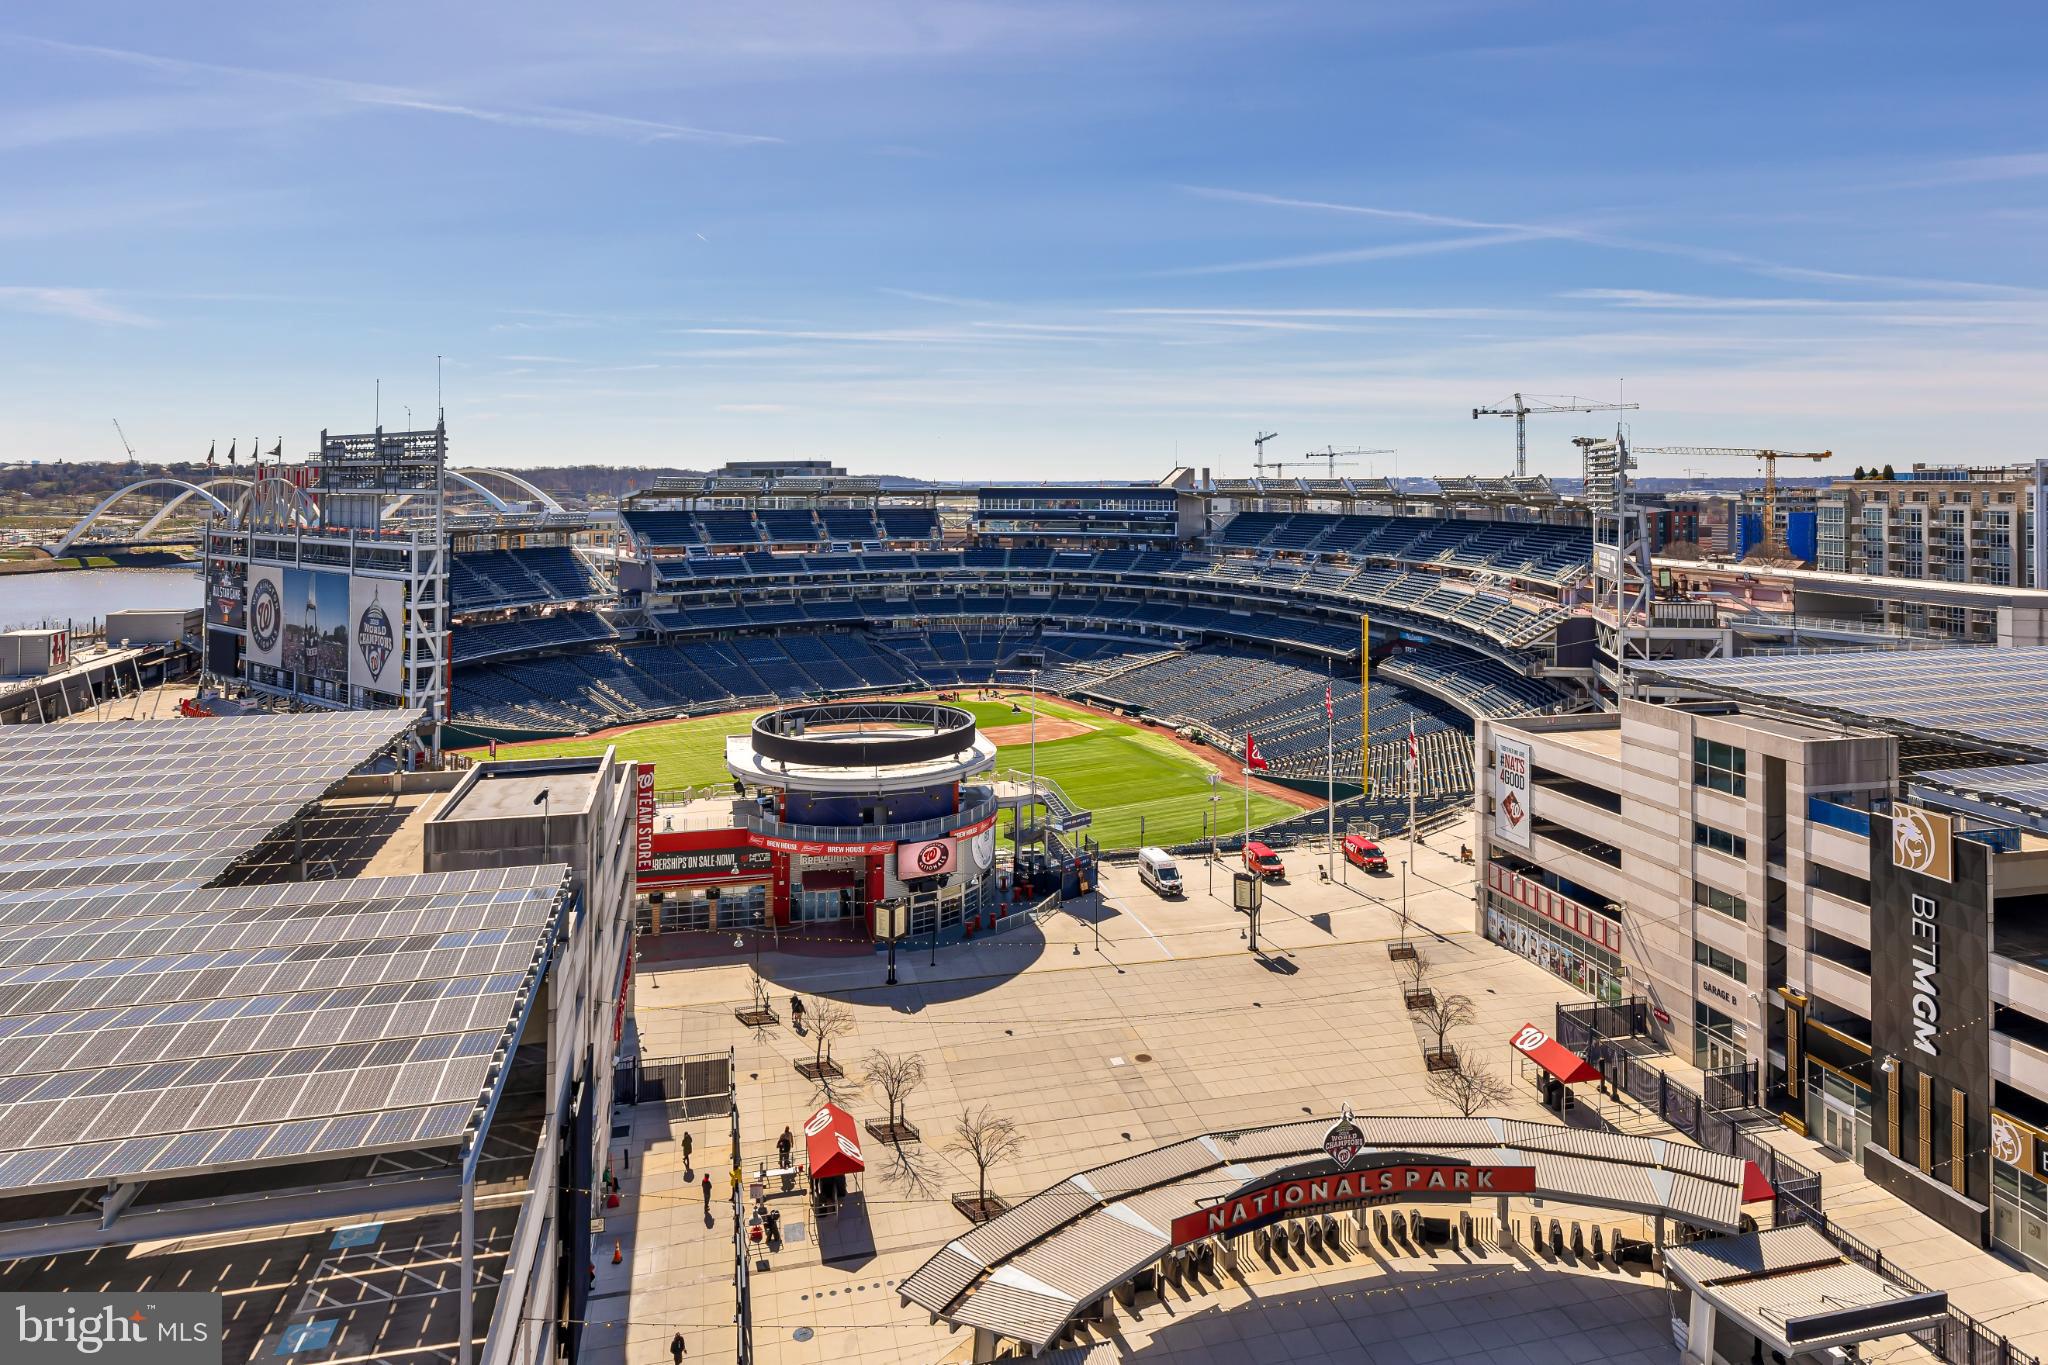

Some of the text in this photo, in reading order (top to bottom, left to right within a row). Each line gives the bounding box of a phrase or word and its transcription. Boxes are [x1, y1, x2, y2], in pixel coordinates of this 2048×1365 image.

[364, 621, 387, 636] WORLD
[360, 632, 393, 651] CHAMPIONS
[1500, 752, 1525, 774] #NATS
[1500, 768, 1525, 790] 4GOOD
[638, 791, 653, 867] TEAM STORE
[688, 857, 698, 868] ON
[699, 855, 715, 867] SALE
[715, 853, 735, 866] NOW!
[1912, 894, 1937, 1056] BETMGM
[1703, 981, 1737, 1005] GARAGE B
[1325, 1138, 1363, 1150] CHAMPIONS
[1331, 1133, 1357, 1141] WORLD
[1208, 1171, 1496, 1230] NATIONALS PARK
